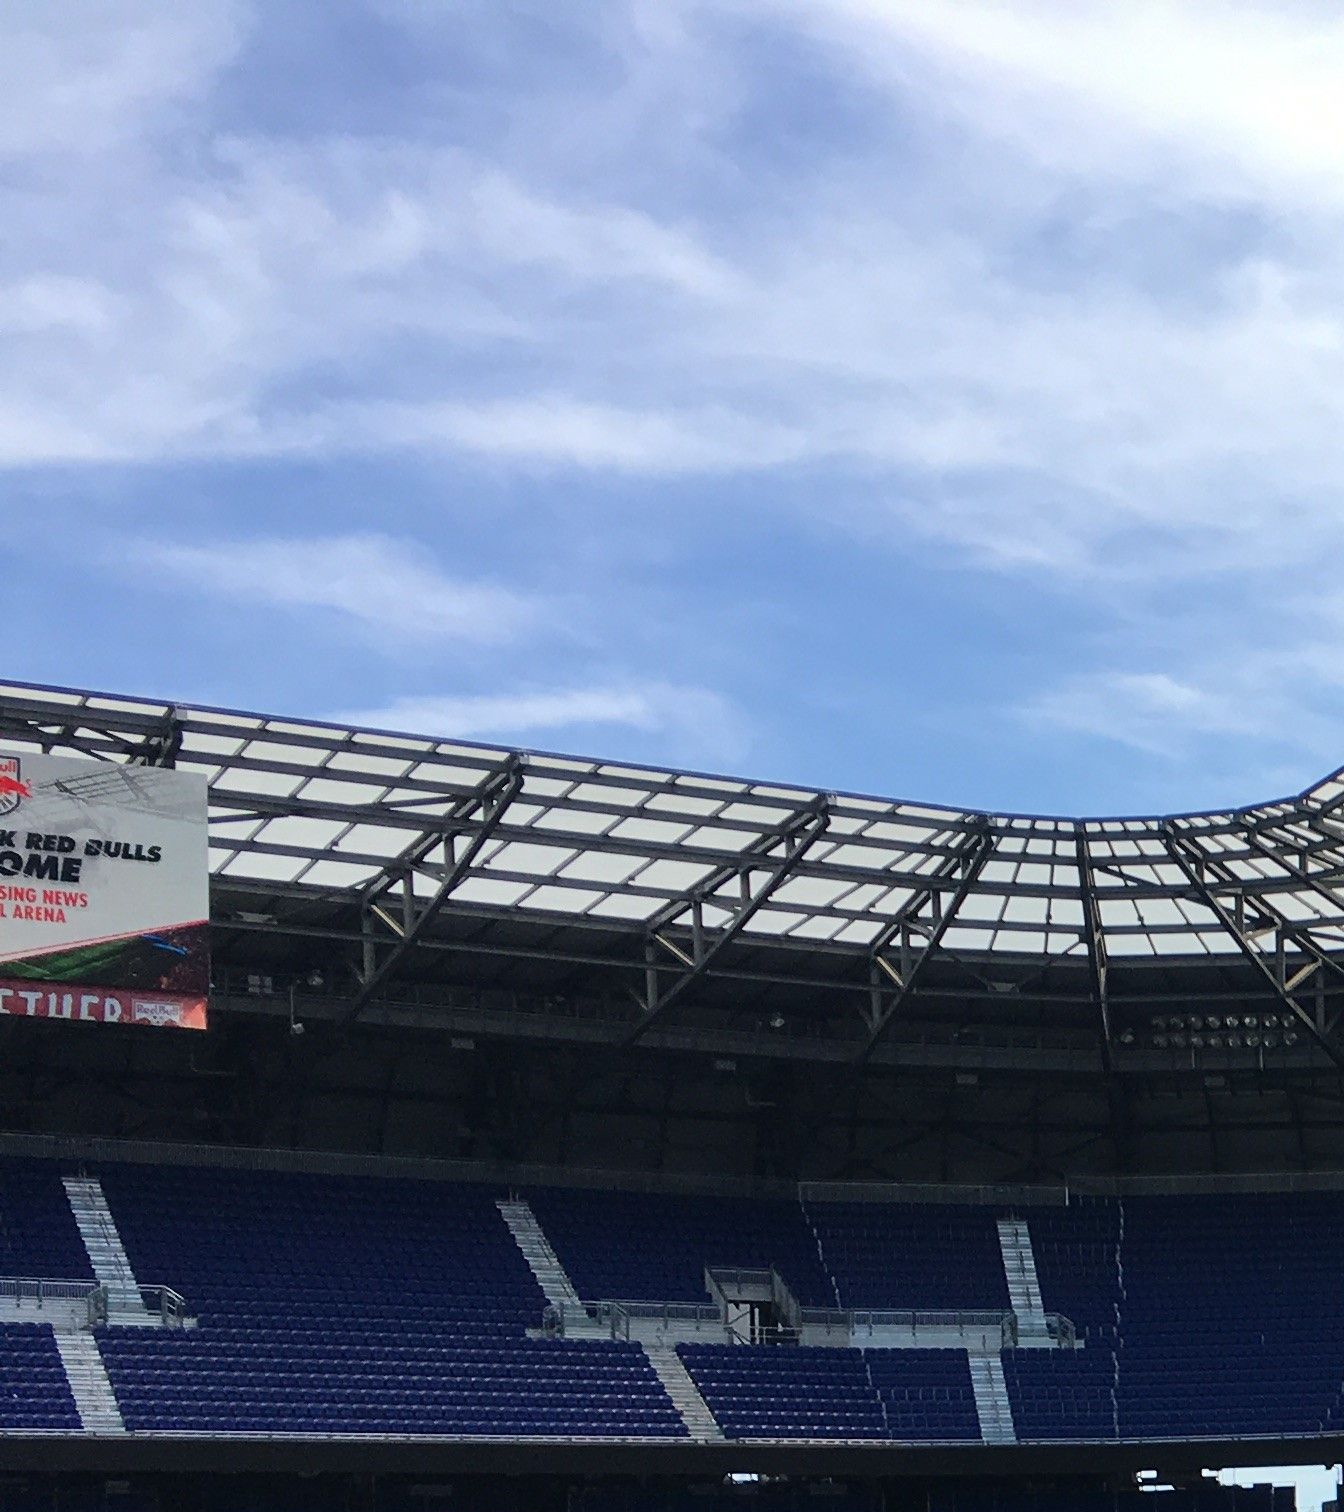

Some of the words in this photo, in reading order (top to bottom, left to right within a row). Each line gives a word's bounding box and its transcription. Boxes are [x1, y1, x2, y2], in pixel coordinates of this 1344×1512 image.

[25, 832, 76, 853] RED
[84, 838, 162, 863] BULLS
[42, 889, 89, 908] NEWS
[13, 905, 66, 924] ARENA
